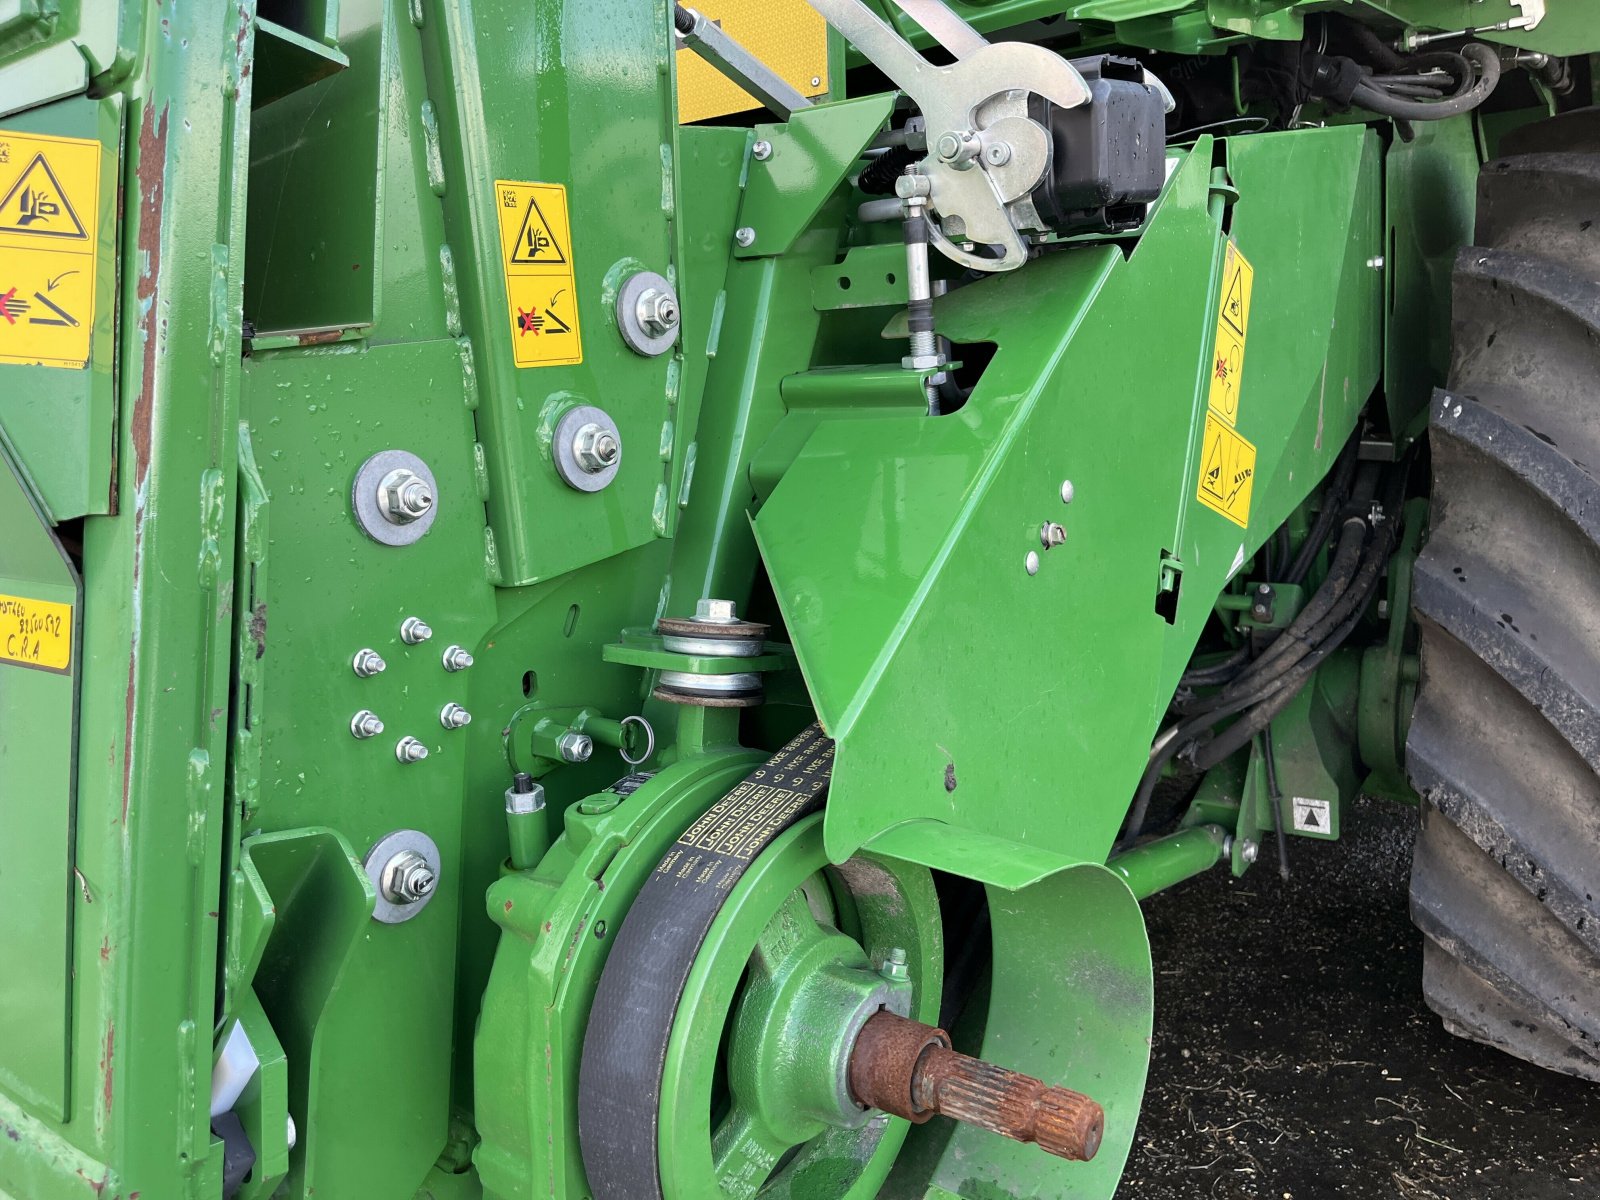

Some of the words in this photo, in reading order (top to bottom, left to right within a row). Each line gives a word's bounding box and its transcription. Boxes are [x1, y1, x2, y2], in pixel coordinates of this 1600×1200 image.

[766, 751, 789, 767] HXE
[784, 755, 807, 771] HXE
[803, 758, 826, 774] HXE
[686, 813, 717, 841] JOHN
[712, 784, 751, 813] DEERE
[705, 818, 735, 846] JOHN
[731, 788, 767, 817] DEERE
[724, 822, 755, 851] JOHN
[750, 791, 787, 822] DEERE
[744, 827, 774, 856] JOHN
[772, 796, 808, 826] DEERE
